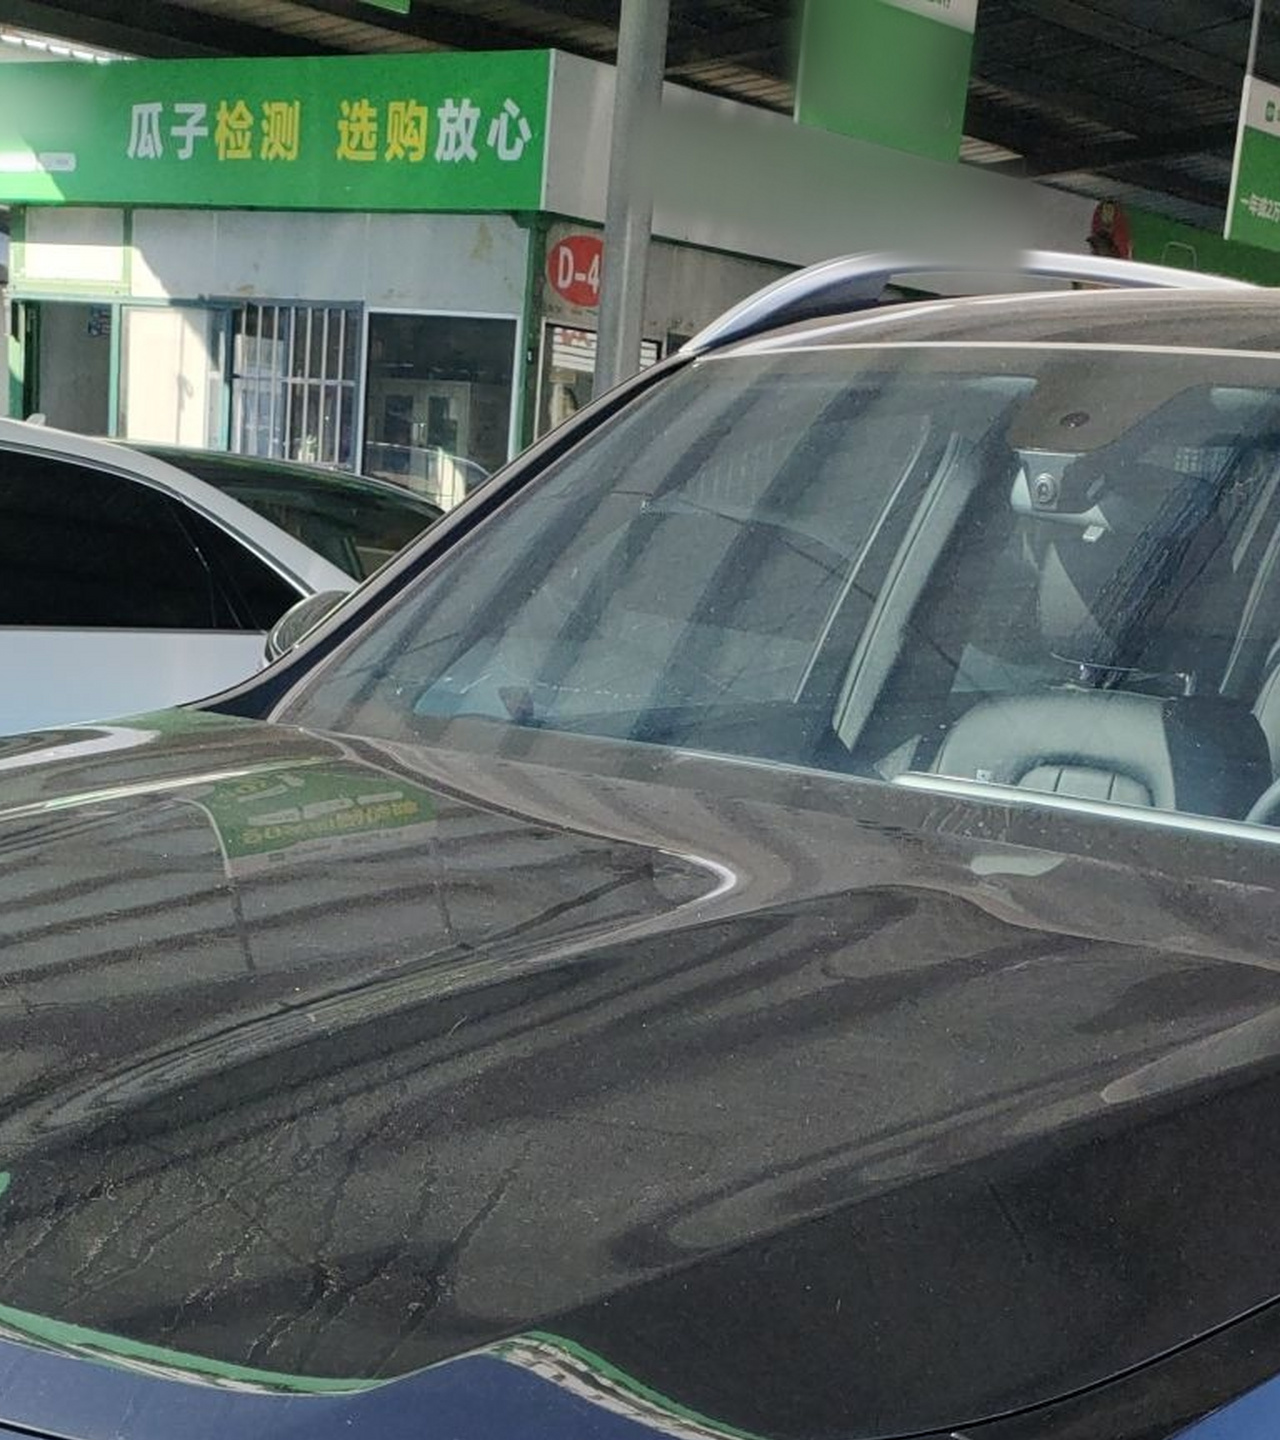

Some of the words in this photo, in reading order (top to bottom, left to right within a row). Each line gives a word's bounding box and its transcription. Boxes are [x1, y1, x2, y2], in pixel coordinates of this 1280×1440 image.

[127, 99, 300, 161] 瓜子检测
[336, 98, 533, 163] 选购放心
